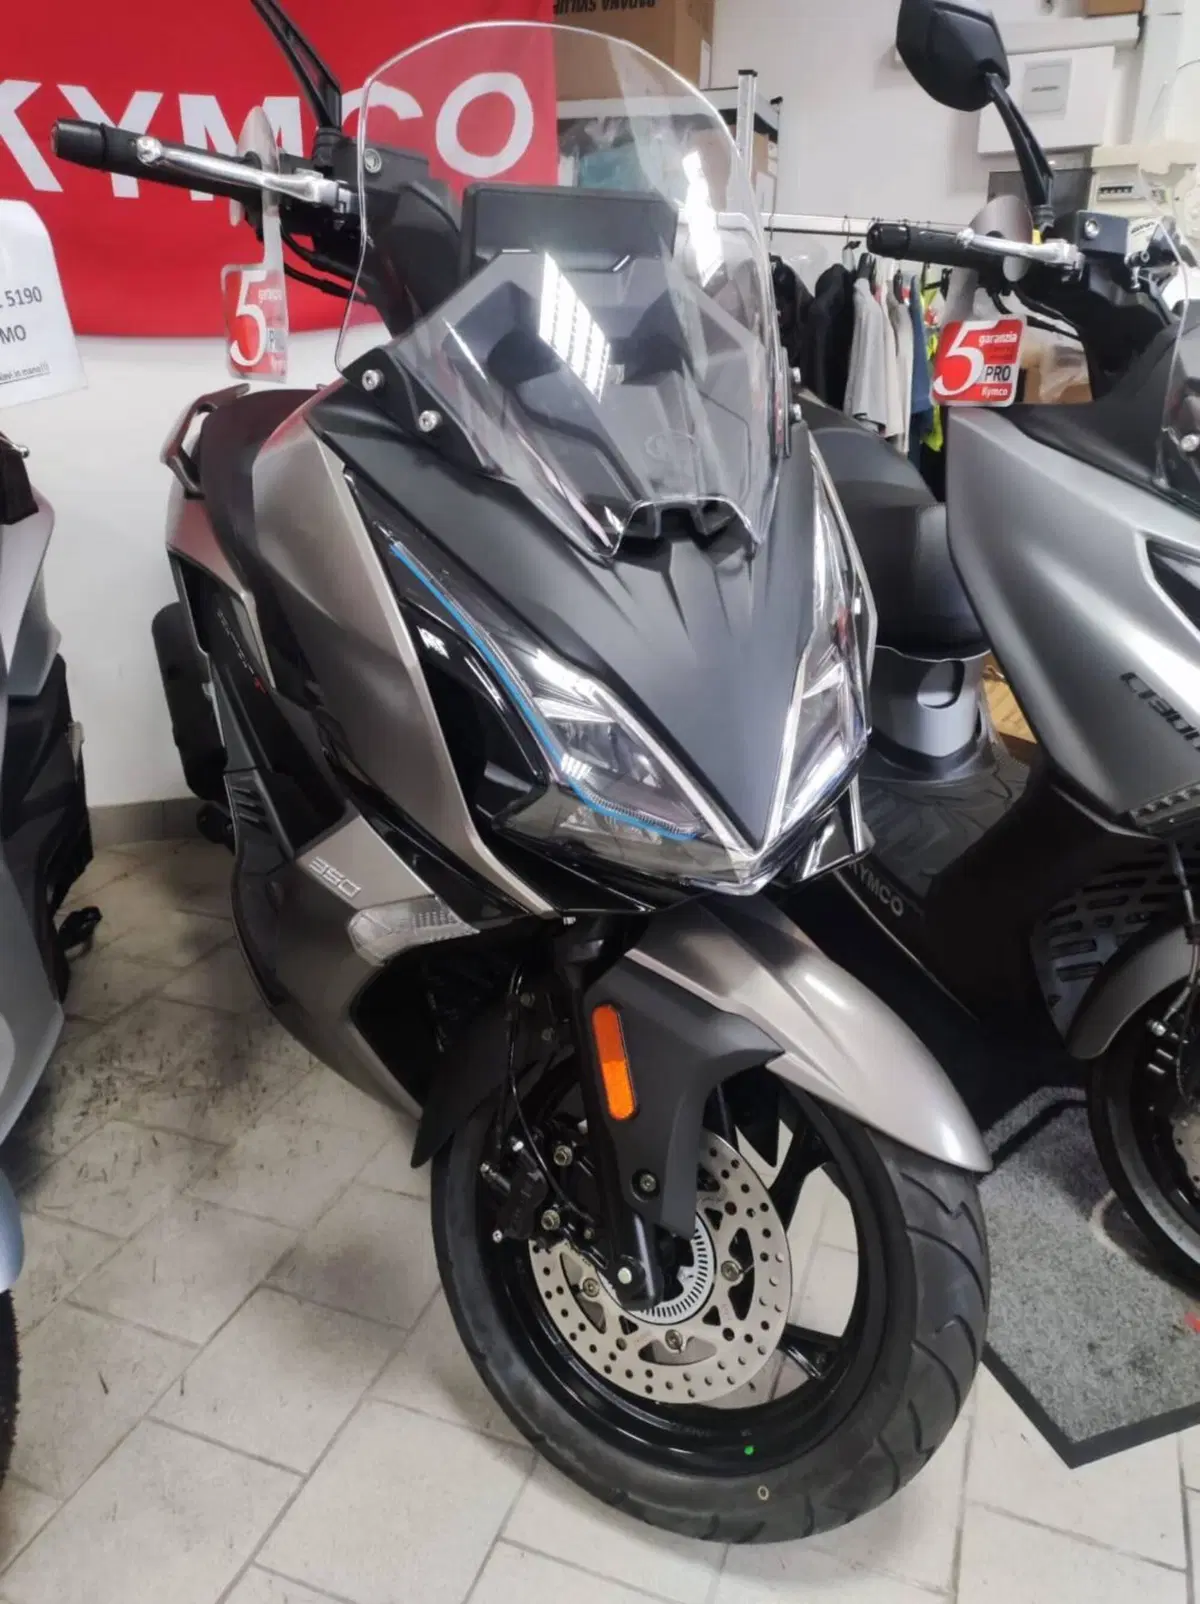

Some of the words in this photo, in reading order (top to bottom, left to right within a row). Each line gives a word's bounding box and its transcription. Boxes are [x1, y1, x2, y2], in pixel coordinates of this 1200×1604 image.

[4, 286, 42, 308] 5190
[230, 269, 267, 367] 5
[978, 332, 1017, 346] garanzia
[933, 320, 1000, 396] 5
[985, 365, 1012, 381] PRO
[981, 386, 1008, 398] Kymco
